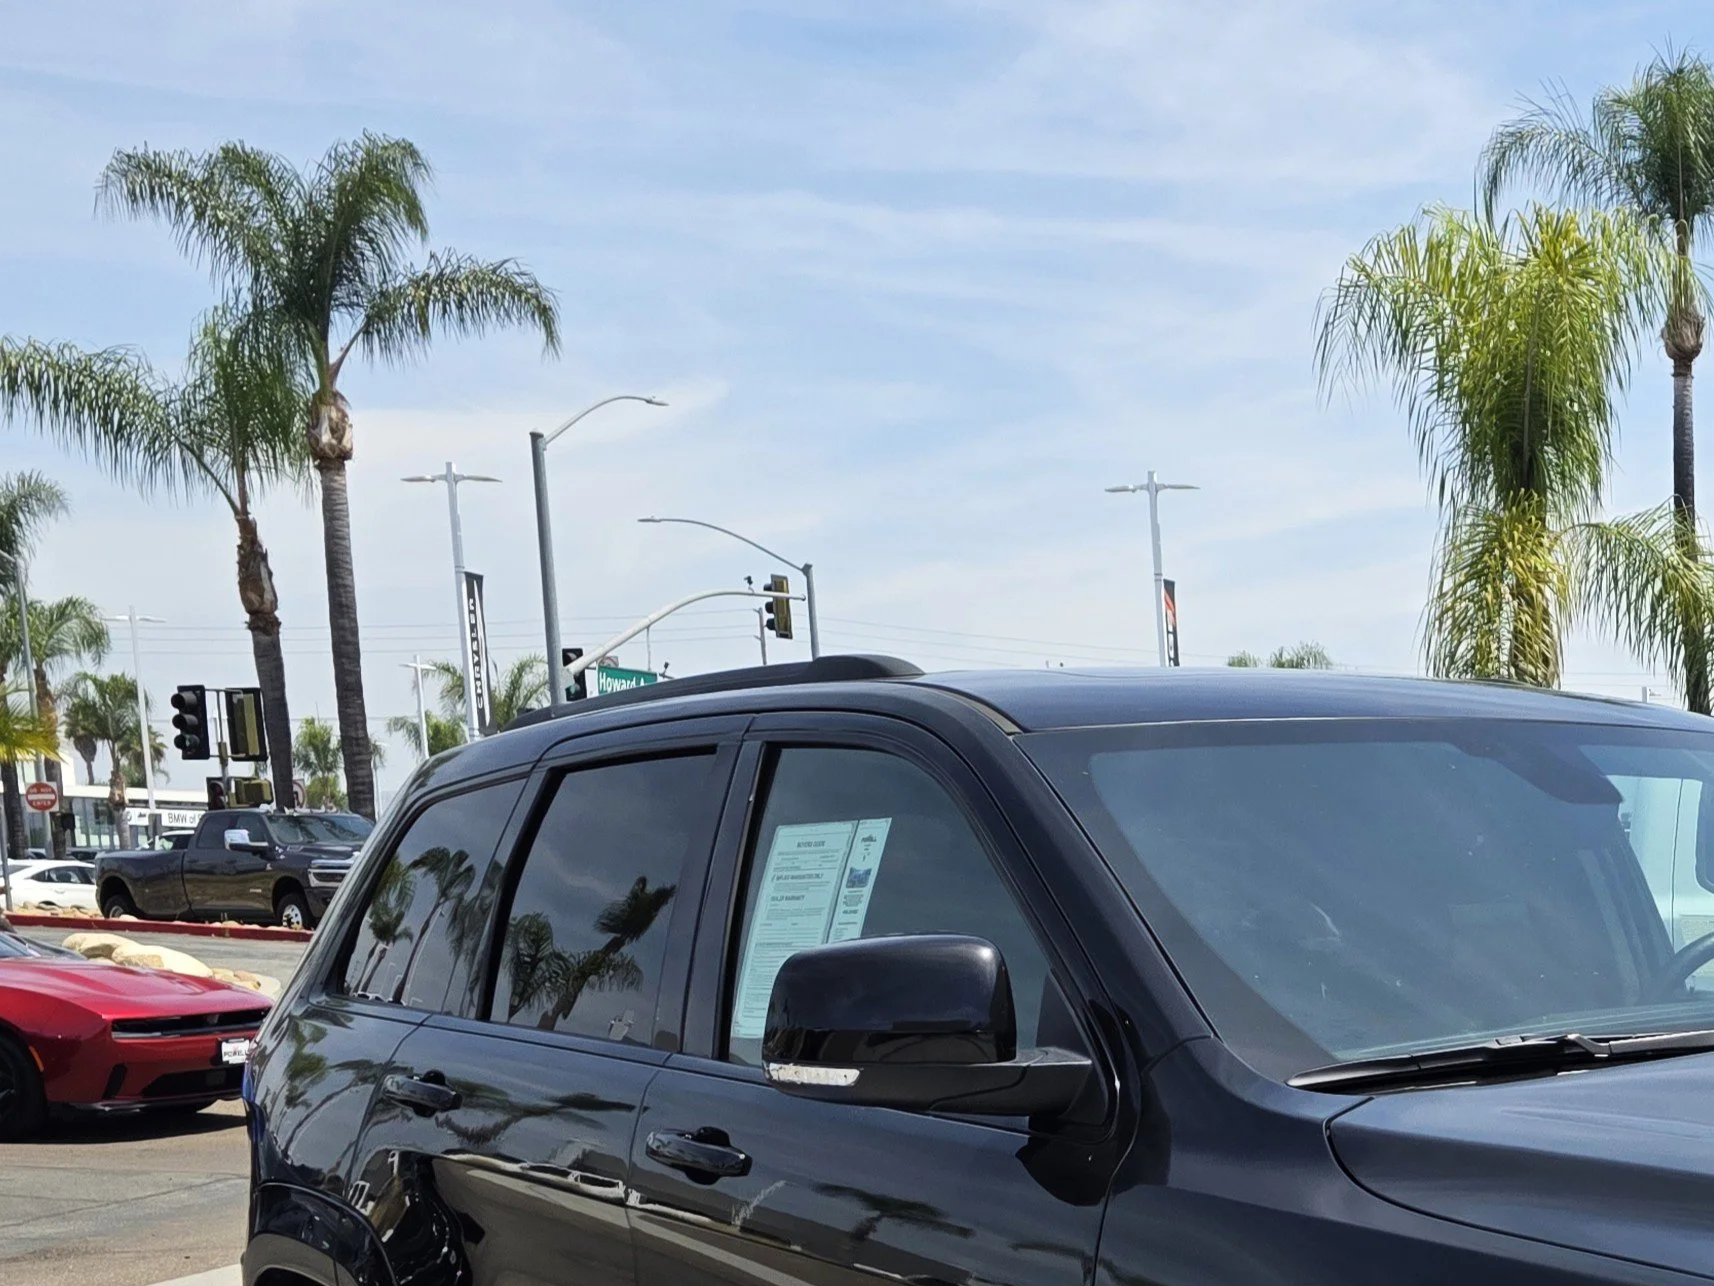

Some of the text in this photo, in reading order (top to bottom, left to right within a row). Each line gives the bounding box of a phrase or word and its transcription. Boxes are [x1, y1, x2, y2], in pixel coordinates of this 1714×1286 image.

[468, 598, 483, 709] CHRYSLER
[599, 671, 637, 691] Howard
[167, 813, 188, 823] BMW
